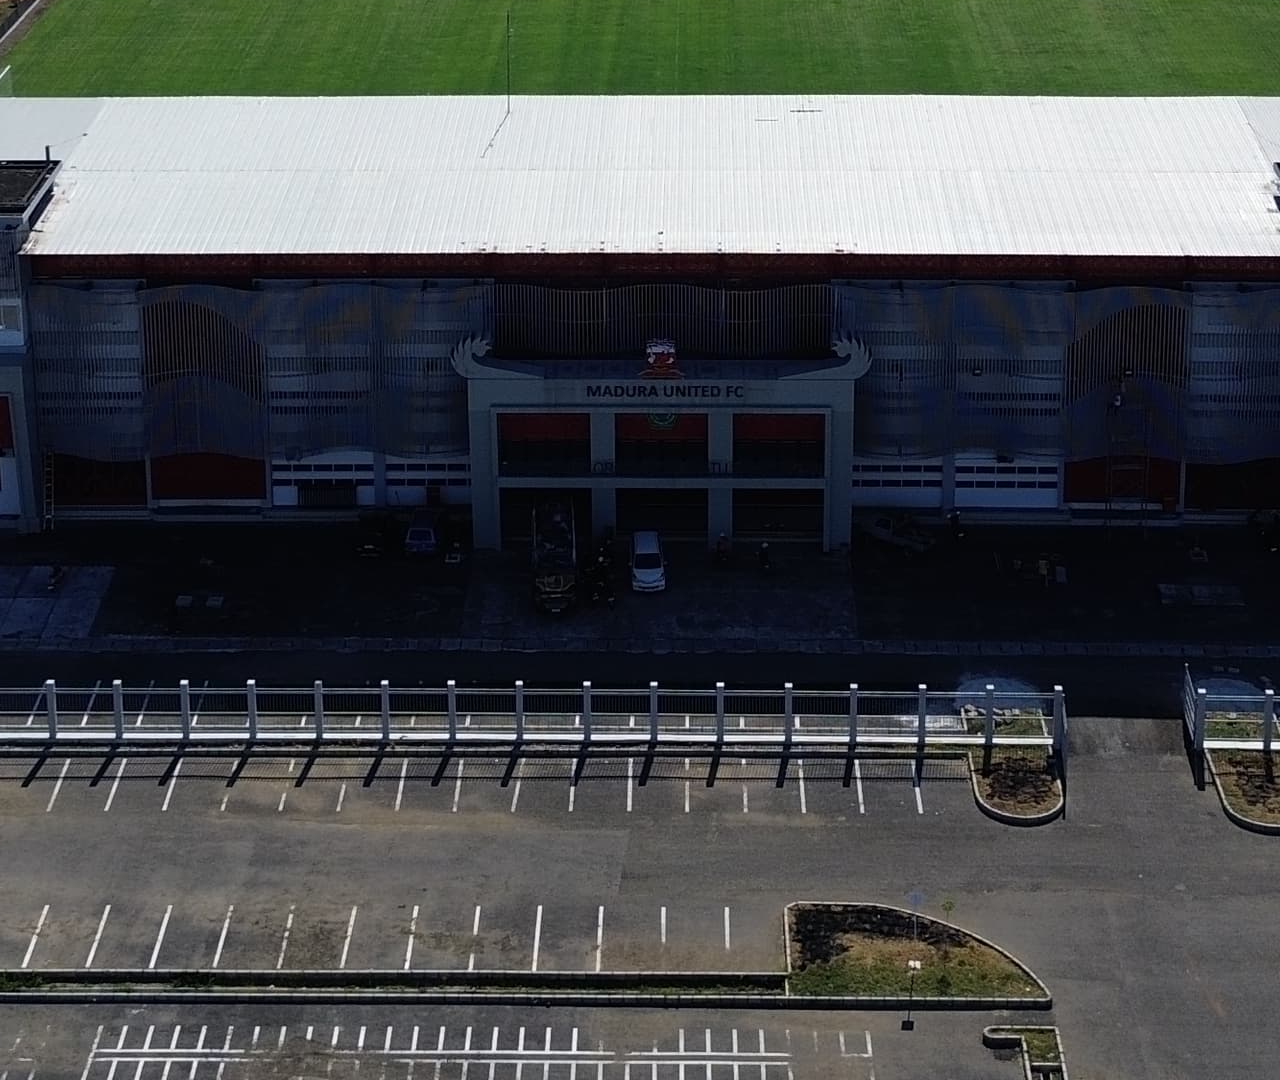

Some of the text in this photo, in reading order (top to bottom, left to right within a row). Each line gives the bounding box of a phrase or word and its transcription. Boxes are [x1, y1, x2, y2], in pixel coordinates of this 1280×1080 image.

[586, 385, 745, 398] MADURA UNITED FC
